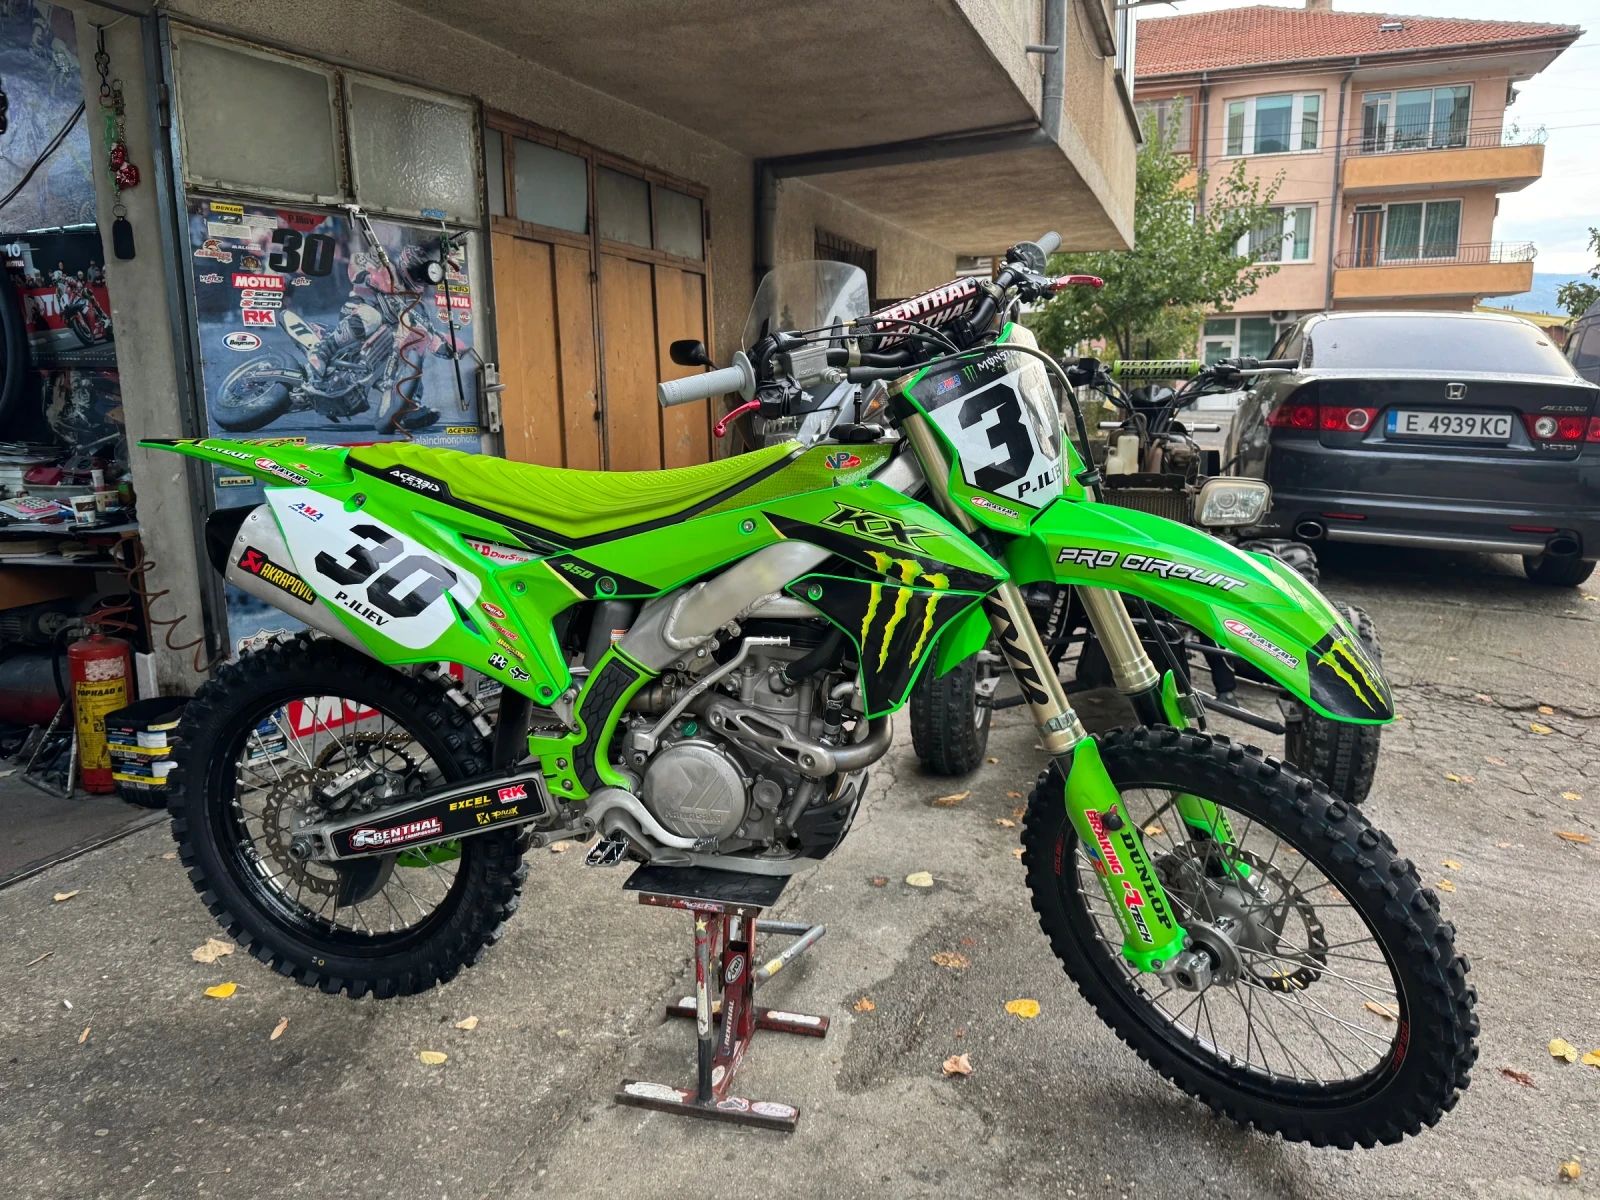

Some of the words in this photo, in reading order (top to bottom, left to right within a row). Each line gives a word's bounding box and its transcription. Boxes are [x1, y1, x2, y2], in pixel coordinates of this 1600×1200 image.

[6, 243, 21, 257] 10
[269, 228, 335, 277] 30
[234, 275, 283, 288] MOTUL
[243, 309, 273, 323] RK
[876, 281, 977, 332] RENTHAL
[1120, 367, 1190, 376] RENTHAL
[1406, 414, 1419, 432] E
[1428, 415, 1477, 434] 4939
[1479, 417, 1507, 436] KC
[826, 452, 850, 469] VP
[389, 470, 440, 492] ACERBIS
[292, 502, 324, 520] AMA
[819, 500, 953, 556] KX
[315, 524, 458, 618] 30
[560, 561, 596, 580] 450
[1057, 547, 1119, 568] PRO
[1120, 553, 1248, 592] CIRCUIT
[334, 590, 390, 627] P.ILIEV
[498, 783, 527, 801] RK
[449, 795, 492, 812] EXCEL
[663, 807, 722, 823] Kawasaki
[373, 818, 441, 842] RENTHAL
[1085, 809, 1125, 876] BRAKING
[1120, 832, 1173, 930] DUNLOP
[728, 959, 742, 979] Arai
[725, 1000, 736, 1048] RENTHAL
